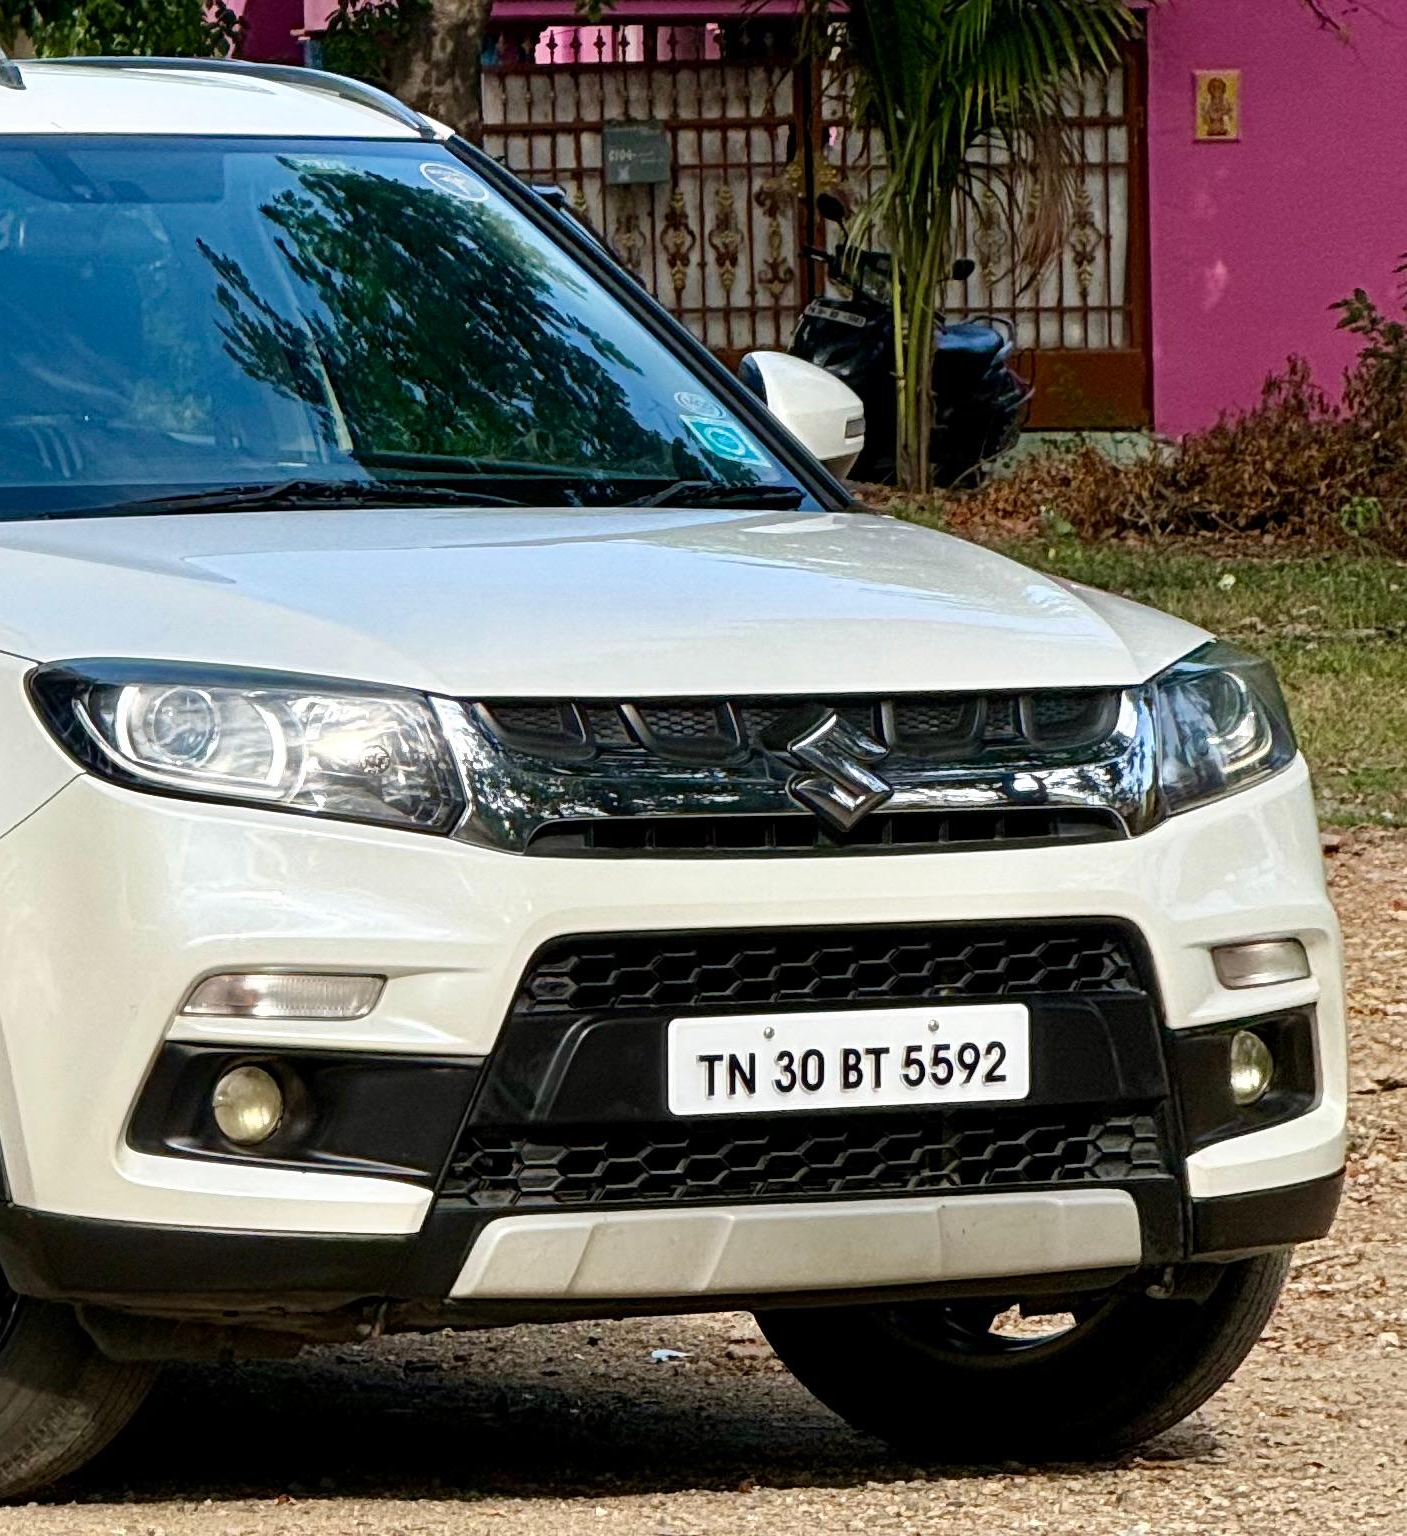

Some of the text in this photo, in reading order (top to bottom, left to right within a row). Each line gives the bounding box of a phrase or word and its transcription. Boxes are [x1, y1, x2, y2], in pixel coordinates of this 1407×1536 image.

[697, 1040, 1007, 1097] TN 30 BT 5592
